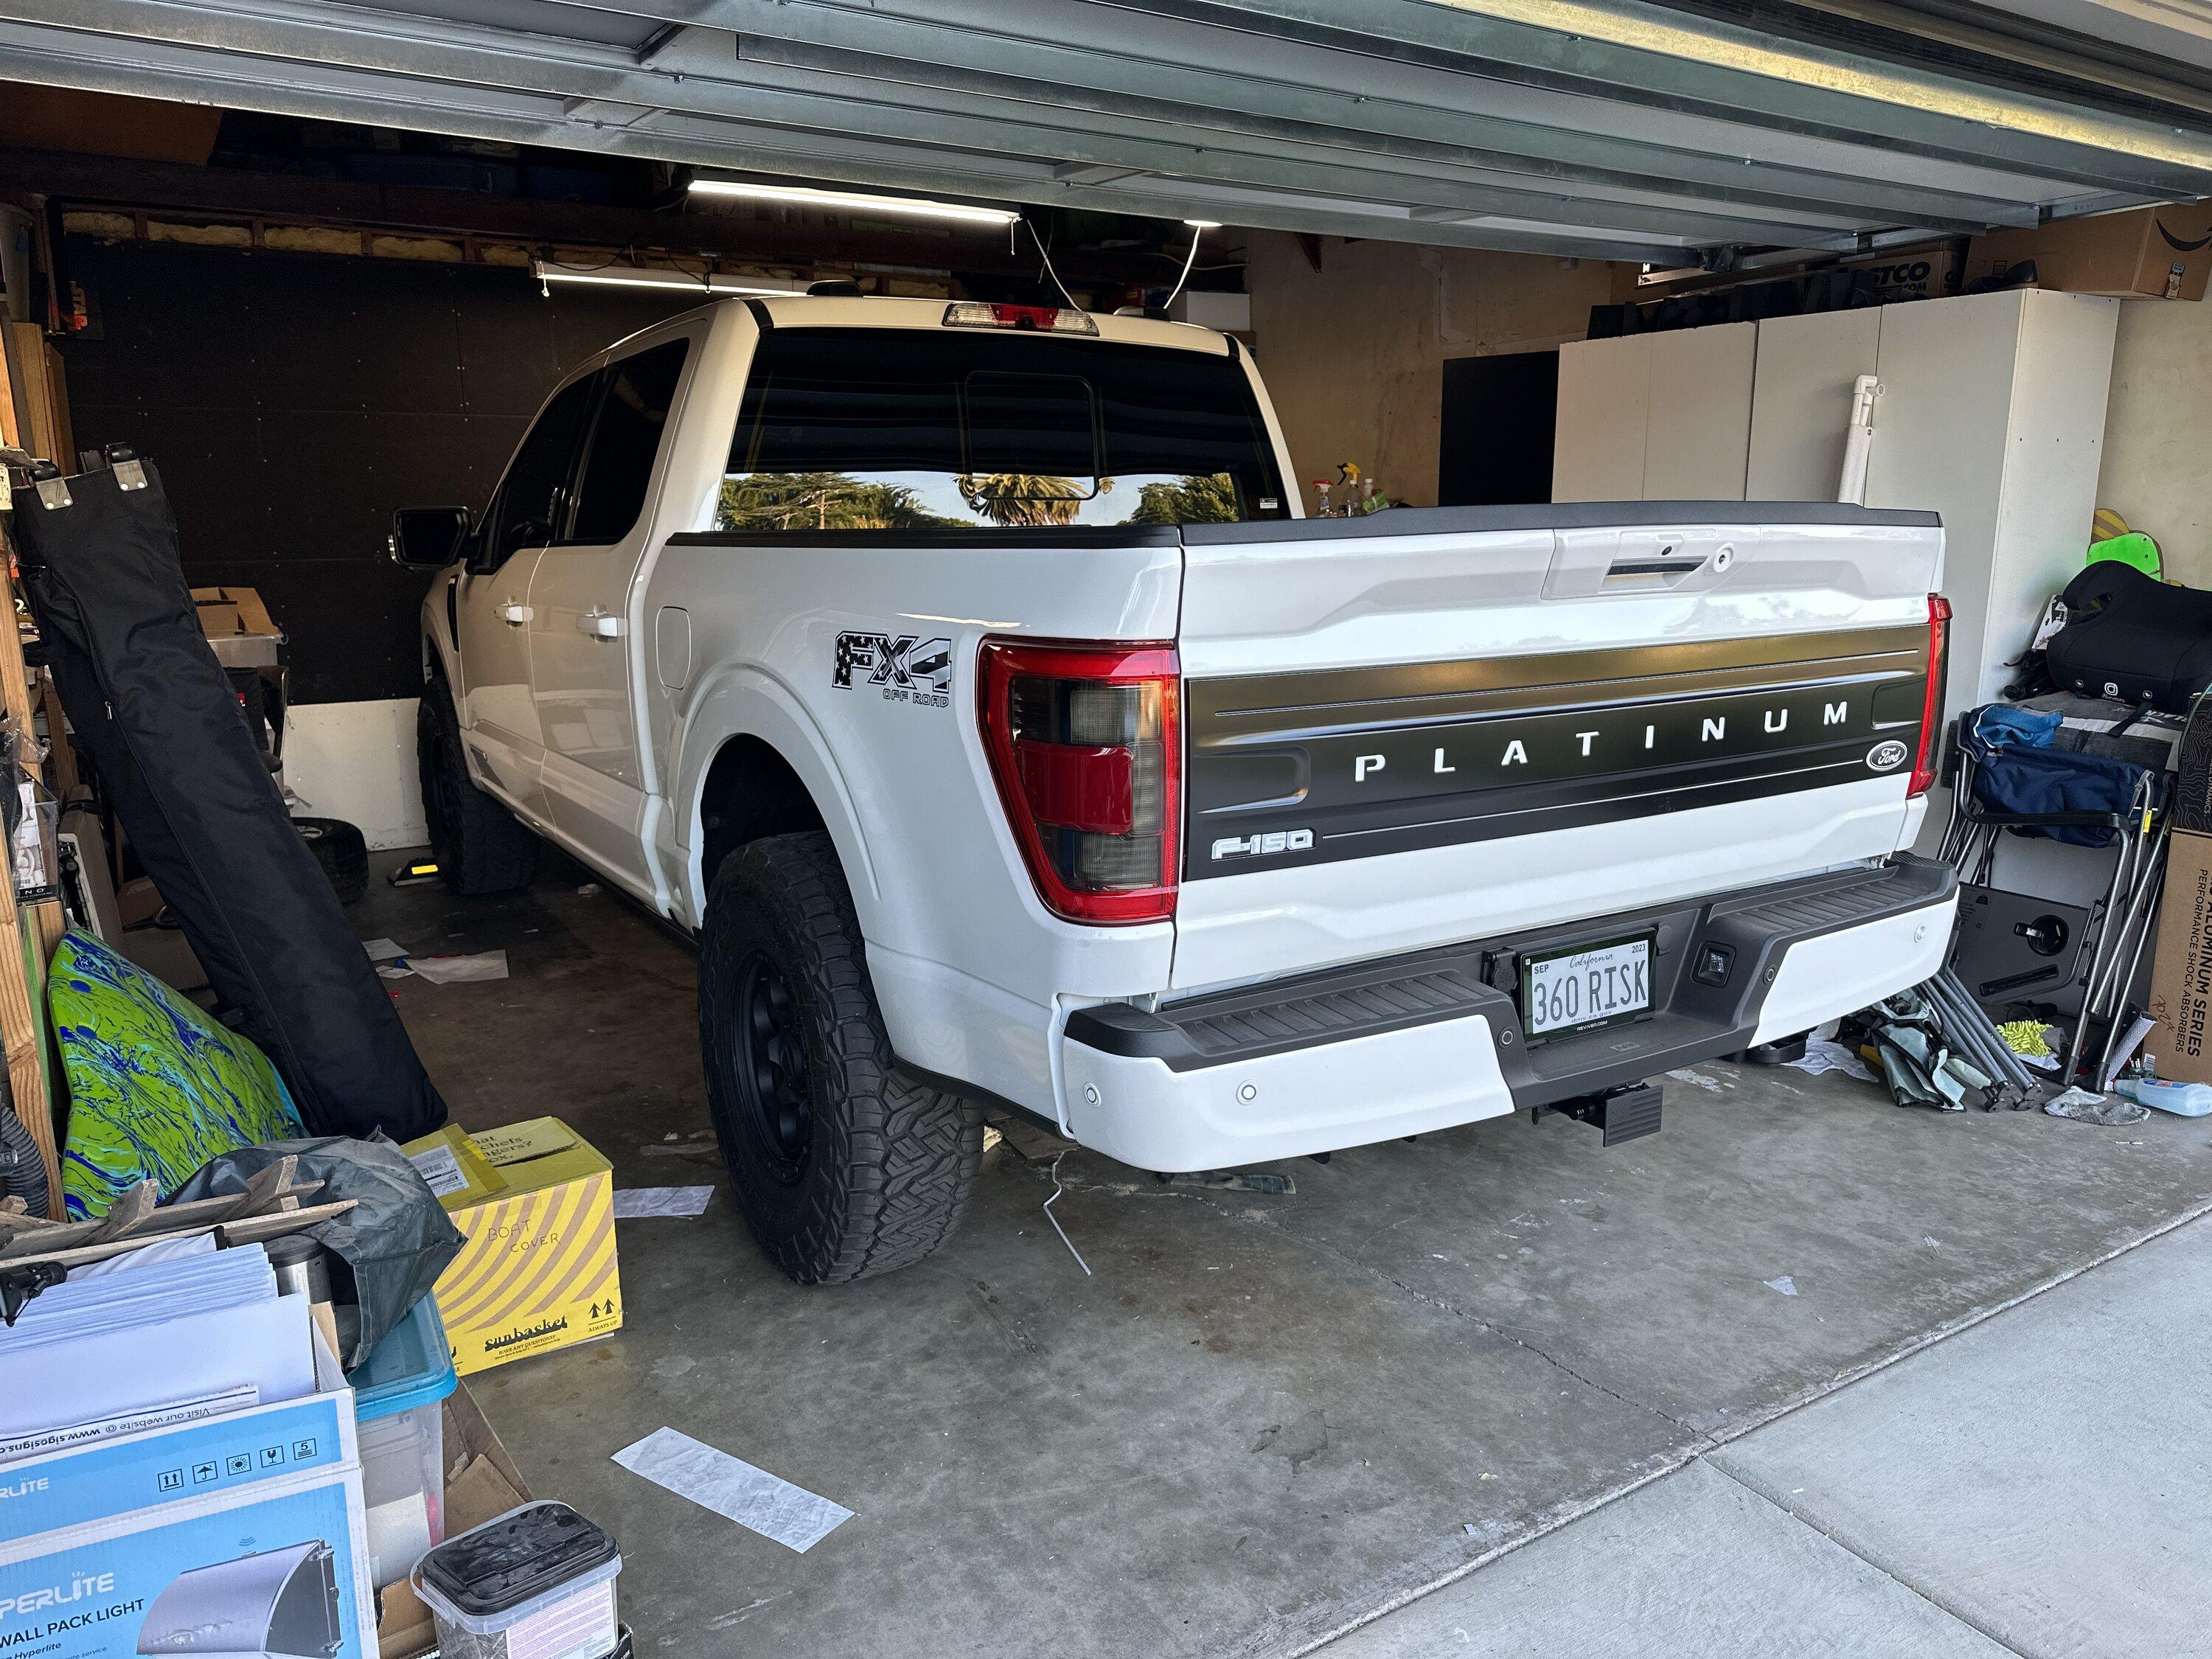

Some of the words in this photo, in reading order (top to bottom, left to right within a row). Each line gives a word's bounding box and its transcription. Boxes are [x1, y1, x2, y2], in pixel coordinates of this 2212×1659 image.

[832, 630, 952, 694] FX4
[883, 689, 908, 701] OFF
[913, 692, 949, 708] ROAD
[1354, 701, 1848, 782] PLATINUM
[1877, 747, 1902, 765] Ford
[1211, 828, 1315, 860] F-150
[2188, 869, 2208, 949] PERFORMANCE
[1534, 964, 1549, 974] SEP
[1632, 944, 1646, 954] 2023
[1569, 952, 1613, 971] California
[2184, 953, 2197, 987] SHOCK
[1534, 975, 1579, 1026] 360
[1589, 959, 1646, 1014] RISK
[1571, 1009, 1613, 1023] dmv.ca.gov
[1576, 1020, 1608, 1032] REVIVER.COM
[2175, 991, 2191, 1053] ABSORBERS
[2187, 998, 2208, 1057] SERIES
[487, 1219, 531, 1242] BOAT
[509, 1232, 561, 1253] COVER
[484, 1315, 568, 1352] sunbasket
[588, 1321, 610, 1332] ALWAYS
[119, 1416, 164, 1431] website
[166, 1412, 184, 1423] our
[187, 1408, 211, 1419] Visit
[47, 1612, 94, 1635] PACK
[97, 1598, 145, 1622] LIGHT
